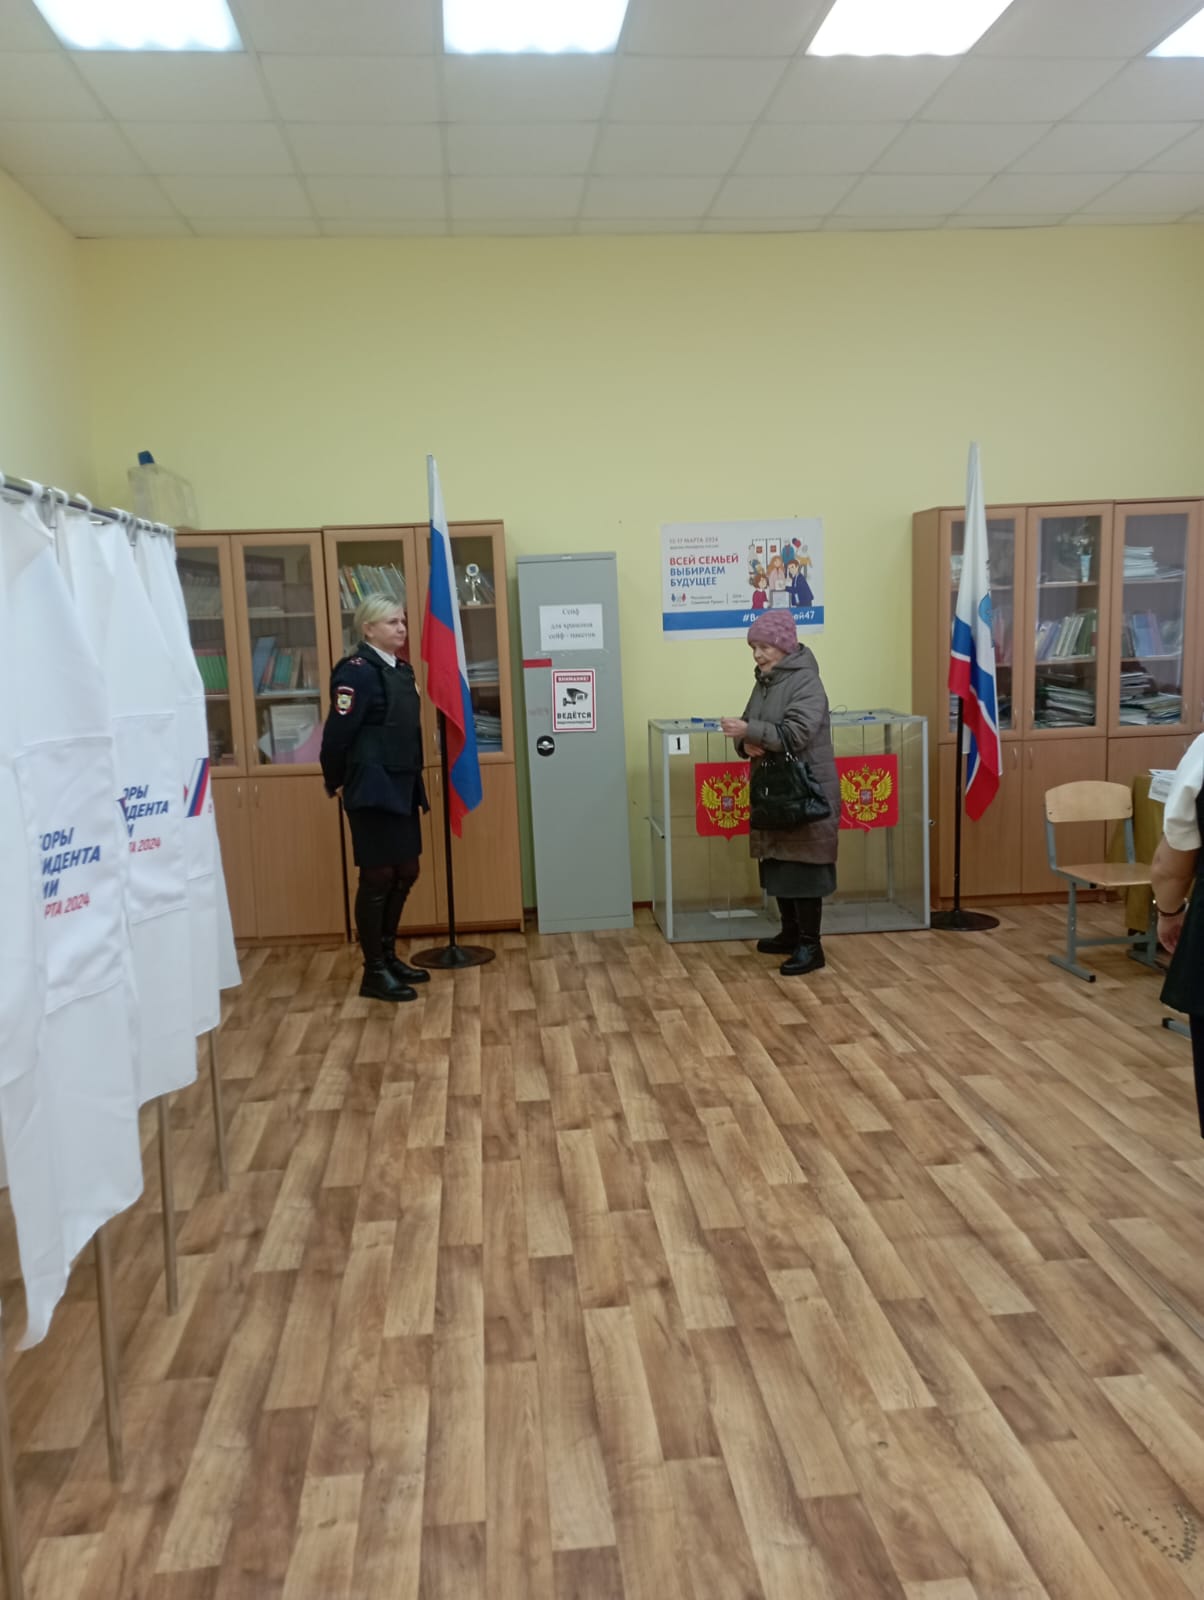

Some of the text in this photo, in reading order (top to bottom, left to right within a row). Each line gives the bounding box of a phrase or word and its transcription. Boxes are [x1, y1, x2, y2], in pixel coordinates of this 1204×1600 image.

[669, 553, 739, 566] ВСЕЙ СЕМЬЕЙ
[670, 566, 725, 577] ВЫБИРАЕМ
[670, 577, 717, 588] БУДУЩЕЕ
[557, 711, 591, 720] ВЕДЁТСЯ
[676, 736, 681, 751] 1
[39, 826, 75, 852] ОРЫ
[137, 837, 161, 852] 2024
[64, 891, 91, 914] 2024
